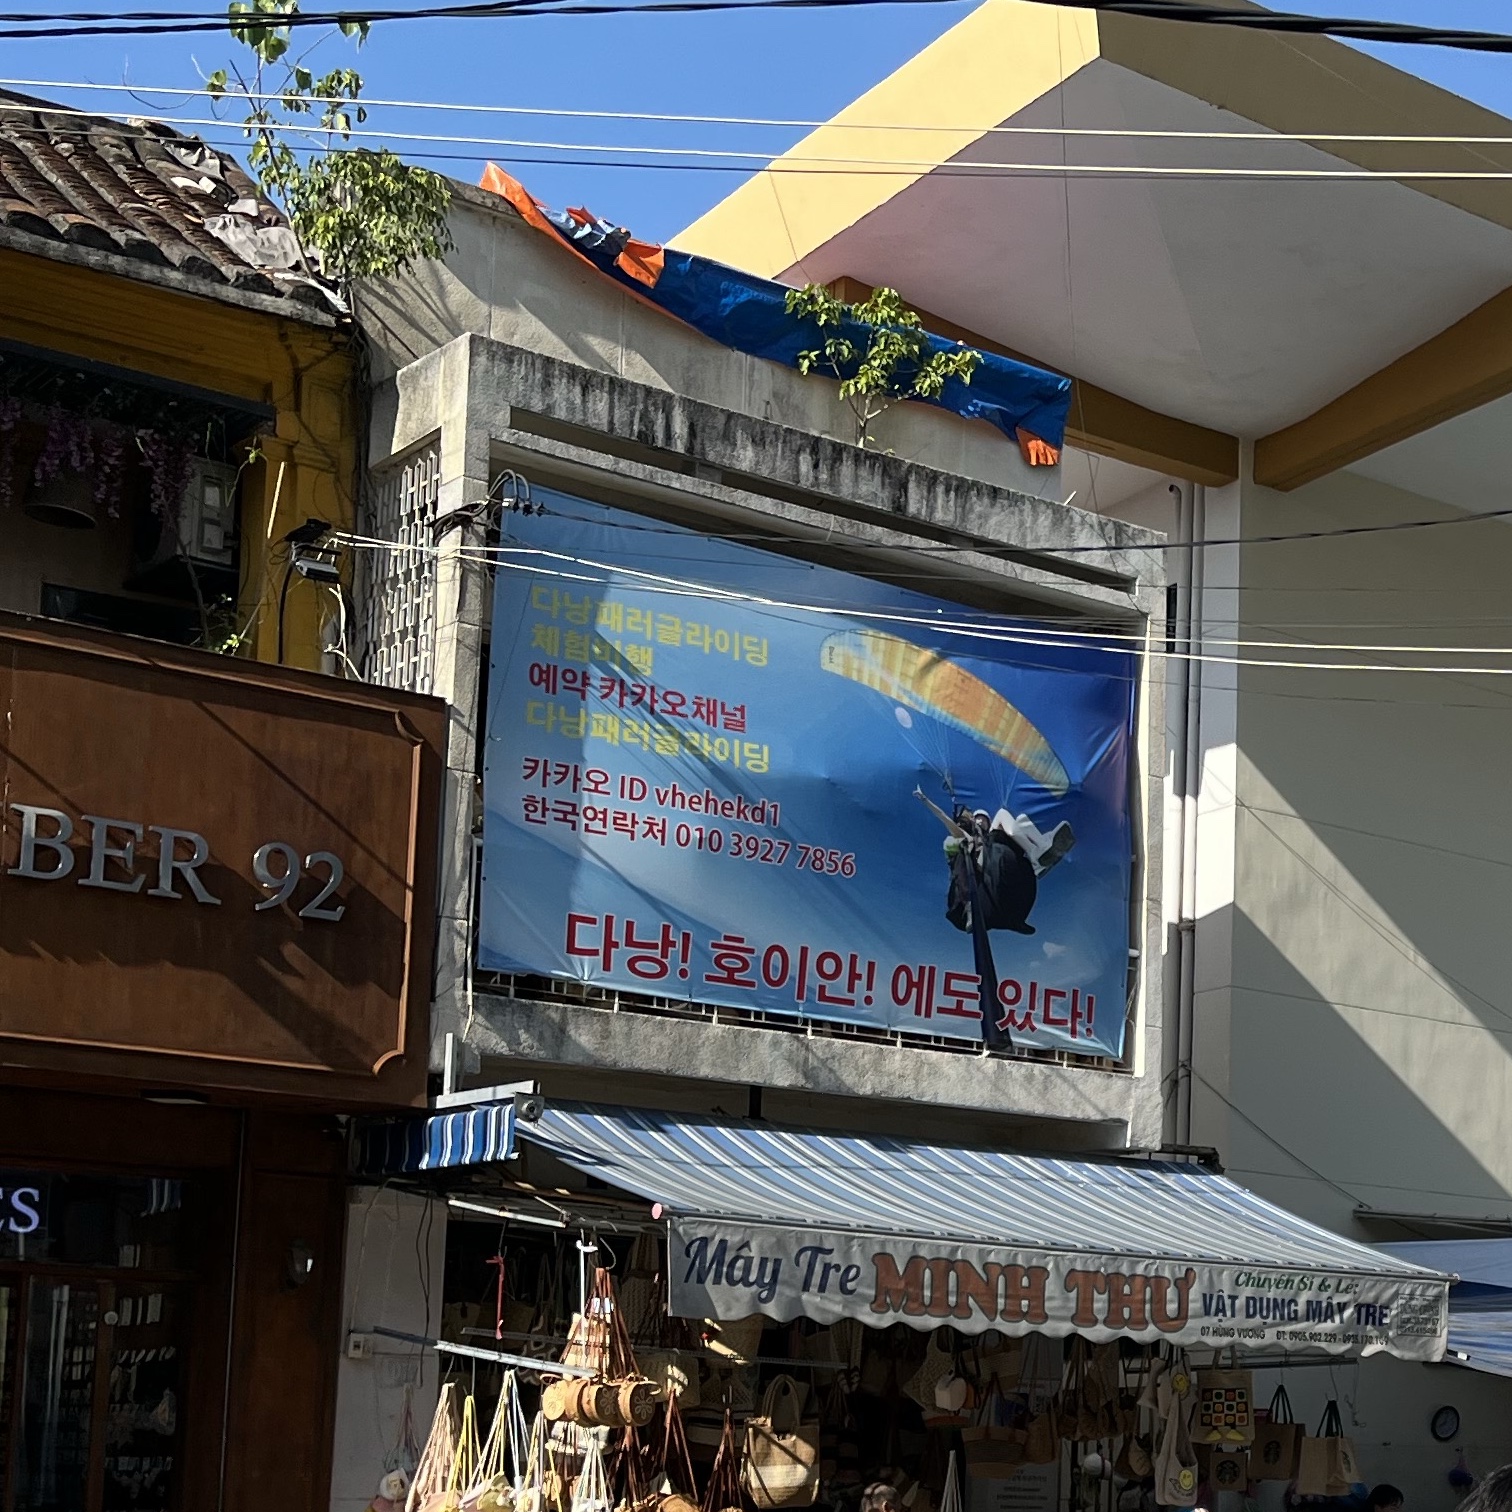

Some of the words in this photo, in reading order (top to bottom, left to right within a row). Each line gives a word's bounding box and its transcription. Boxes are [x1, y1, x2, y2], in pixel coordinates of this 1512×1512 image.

[528, 661, 590, 698] 예약
[599, 673, 747, 734] 카카오채널
[521, 756, 611, 798] 카카오
[619, 774, 648, 803] ID
[655, 783, 781, 828] vhehekd1
[7, 803, 222, 905] BER
[252, 841, 346, 922] 92
[521, 794, 667, 847] 한국연락처
[675, 823, 723, 854] 010
[729, 832, 791, 865] 3927
[796, 844, 856, 878] 7856
[564, 911, 692, 981] 다낭!
[703, 933, 878, 1009] 호이안!
[684, 1236, 784, 1304] Mây
[793, 1245, 861, 1297] Tre
[870, 1251, 1050, 1325] MINH
[1064, 1267, 1197, 1333] THƯ
[1234, 1271, 1295, 1293] Chuyên
[1318, 1277, 1331, 1292] &
[1200, 1326, 1211, 1338] 07
[1202, 1289, 1240, 1323] VẬT
[1244, 1295, 1299, 1326] DỤNG
[1305, 1296, 1351, 1325] MÂY
[1354, 1302, 1391, 1328] TRE
